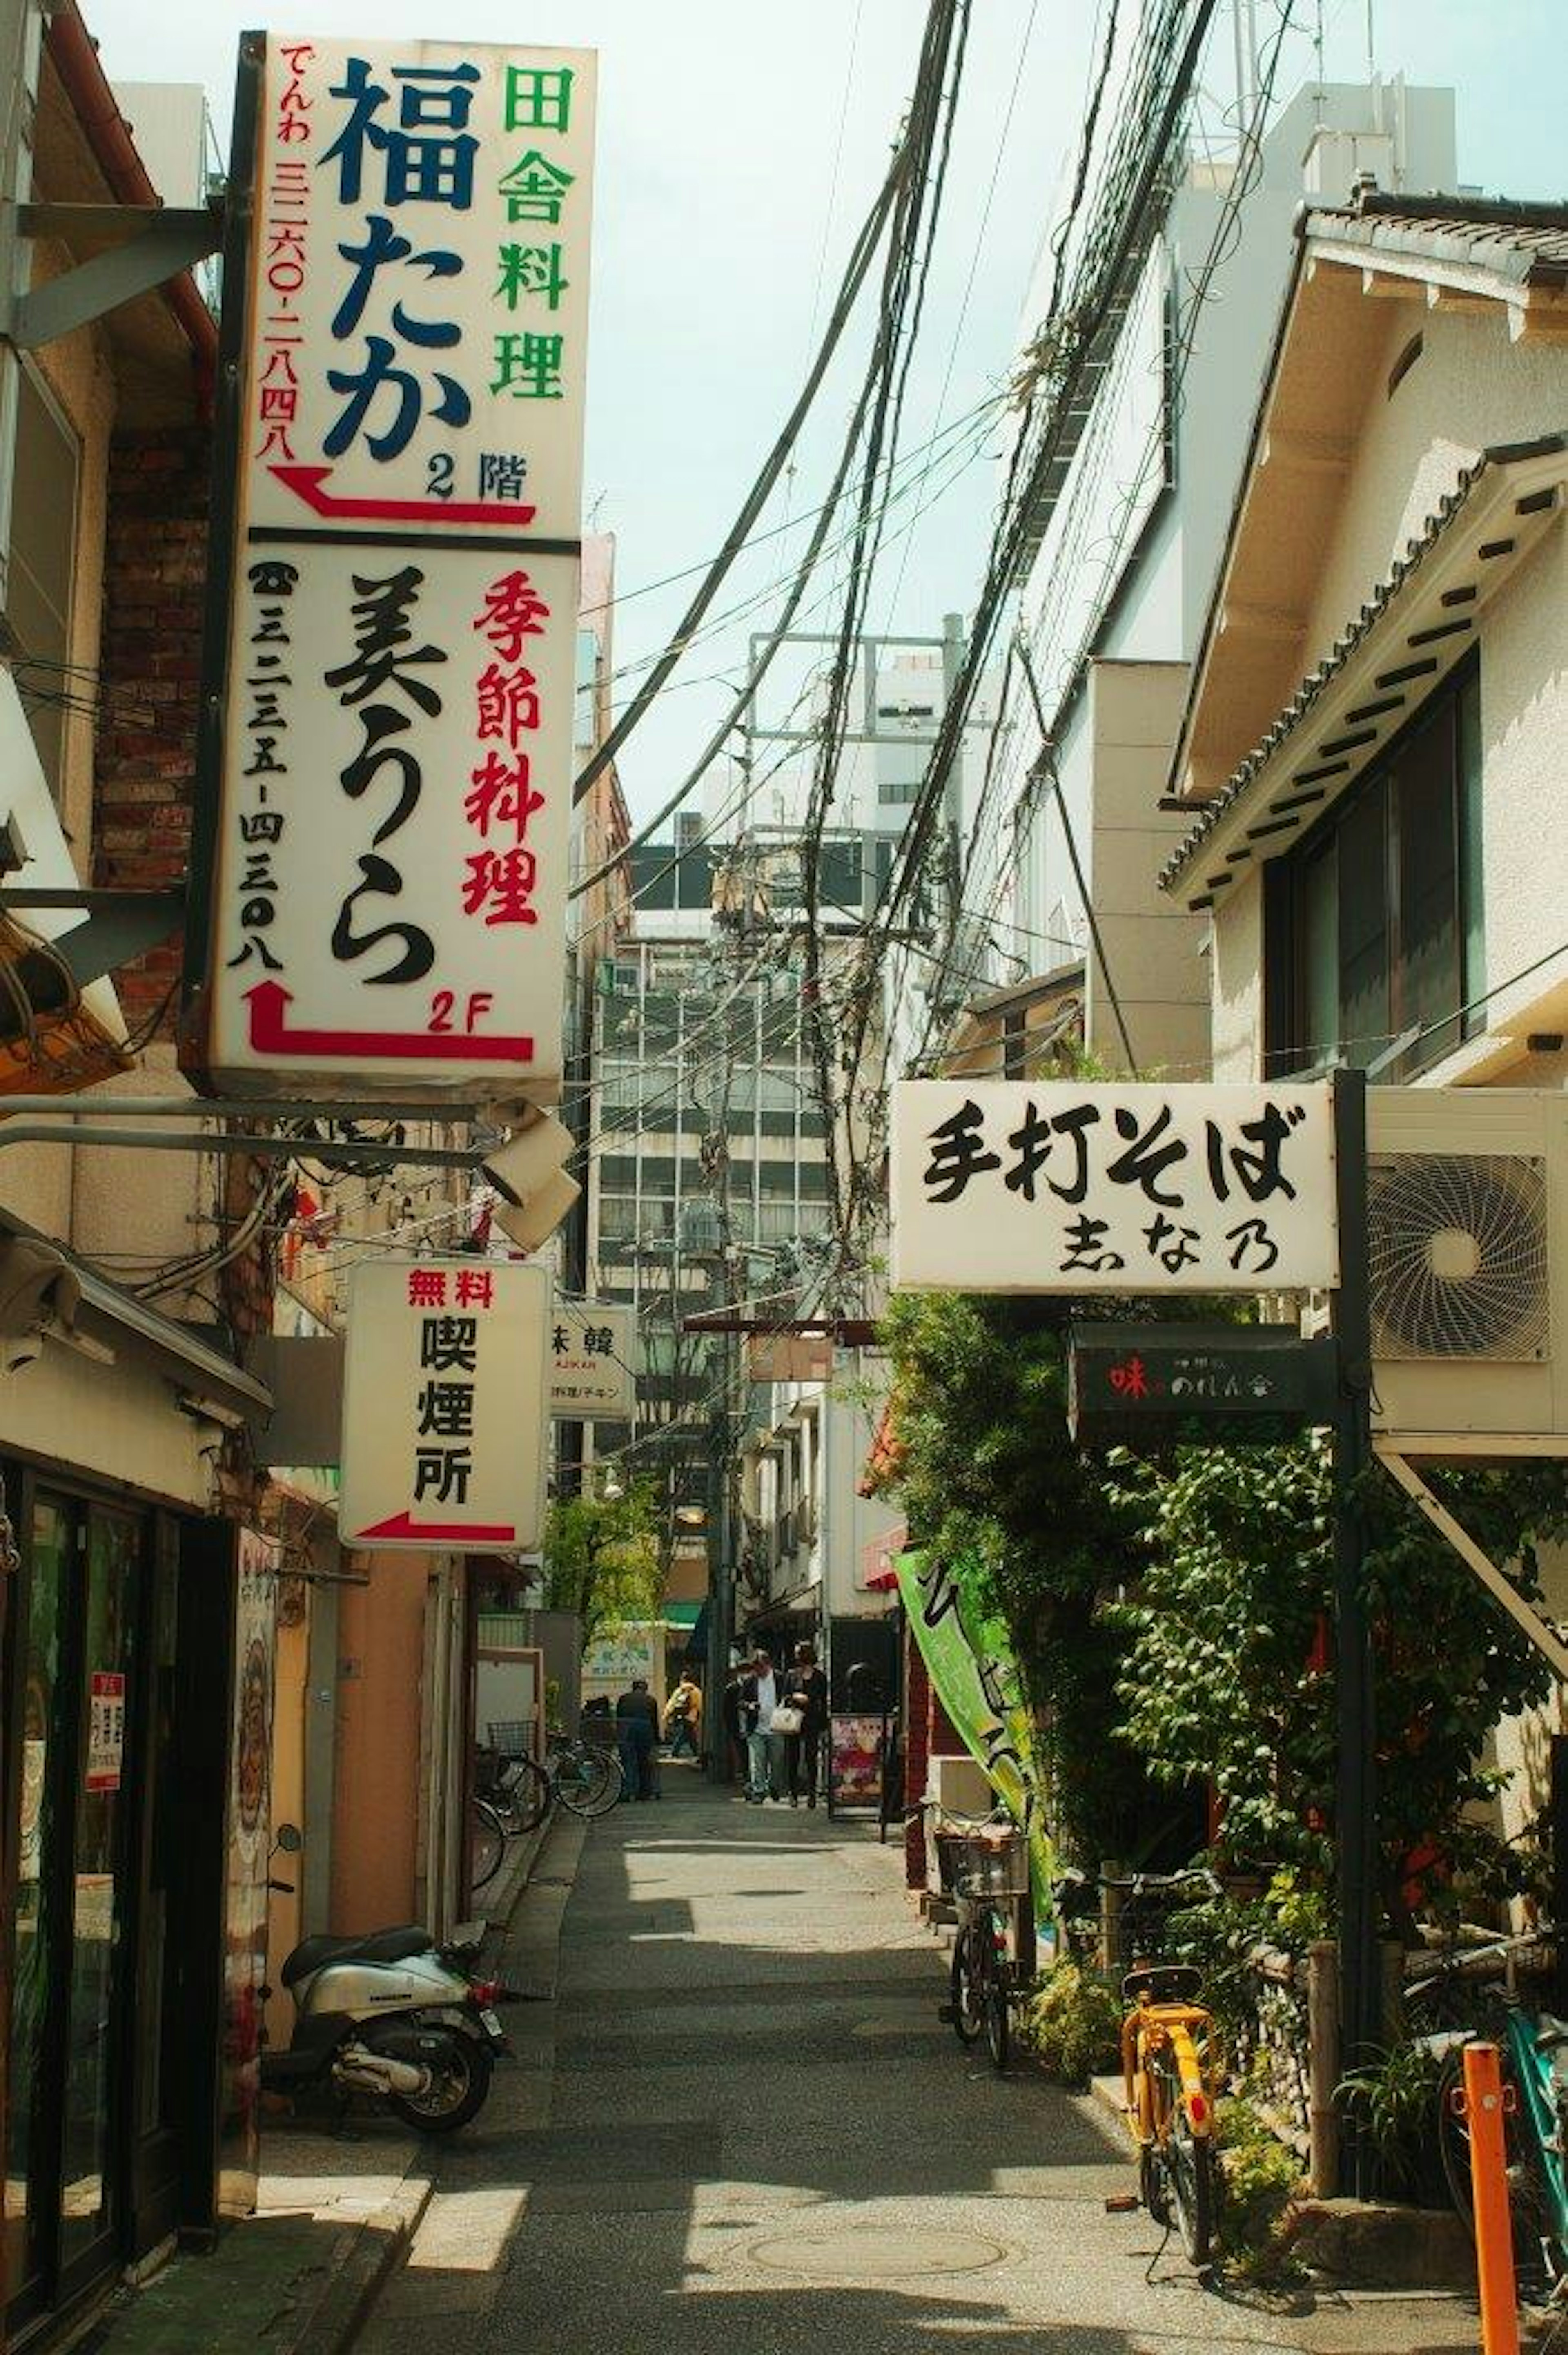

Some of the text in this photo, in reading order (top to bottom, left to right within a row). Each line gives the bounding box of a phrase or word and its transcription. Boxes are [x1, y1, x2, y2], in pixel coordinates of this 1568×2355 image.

[278, 43, 315, 145] でんわ
[316, 58, 481, 463] 福たか
[489, 63, 575, 400] 田舎料理
[426, 453, 528, 500] 2階
[324, 565, 448, 986] 美うら
[458, 569, 552, 930] 季節料理
[427, 990, 493, 1033] 2F
[923, 1099, 1306, 1209] 手打そば
[407, 1268, 497, 1309] 無料
[1059, 1212, 1279, 1275] 志な乃
[413, 1316, 477, 1505] 喫煙所
